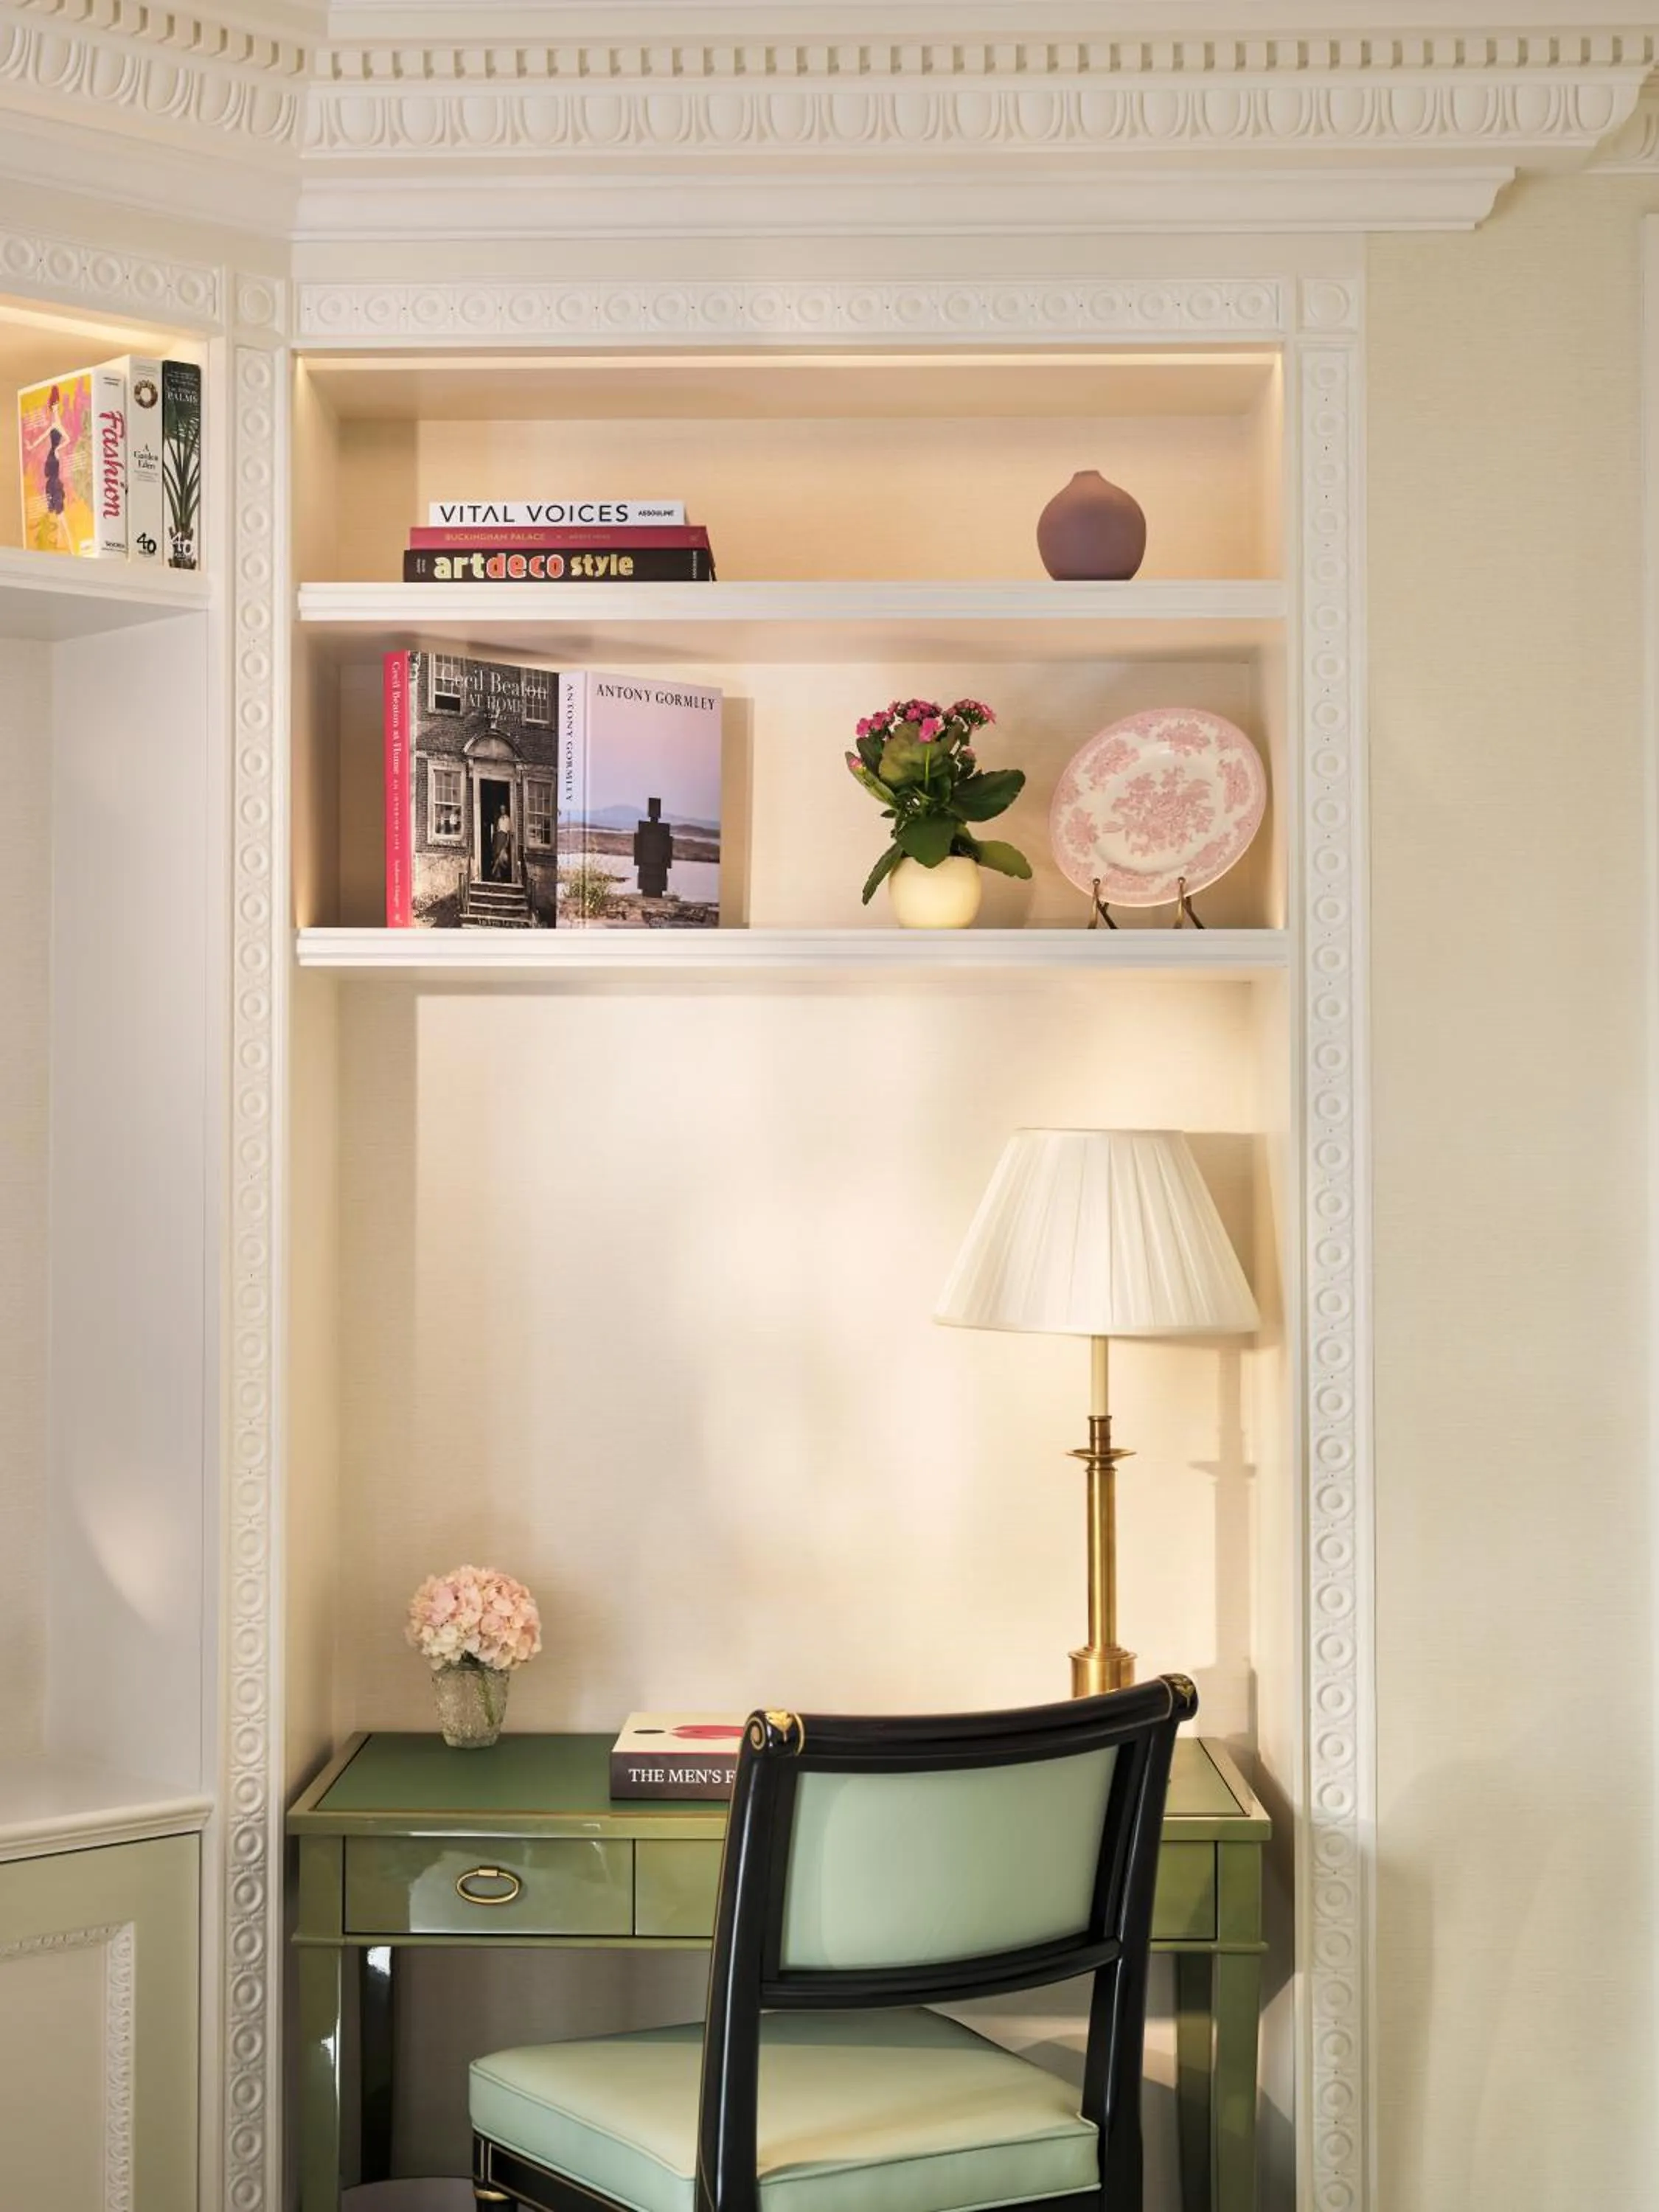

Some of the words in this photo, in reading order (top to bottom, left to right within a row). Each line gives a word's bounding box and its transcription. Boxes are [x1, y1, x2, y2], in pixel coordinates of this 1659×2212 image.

[100, 410, 125, 519] Fashion
[439, 505, 515, 523] VITAL
[526, 504, 629, 524] VOICES
[136, 532, 157, 554] 40
[570, 553, 634, 578] style
[596, 684, 651, 703] ANTONY
[655, 690, 716, 712] GORMLEY
[565, 684, 574, 738] ANTONY
[628, 1768, 664, 1783] THE
[669, 1769, 722, 1784] MEN'S
